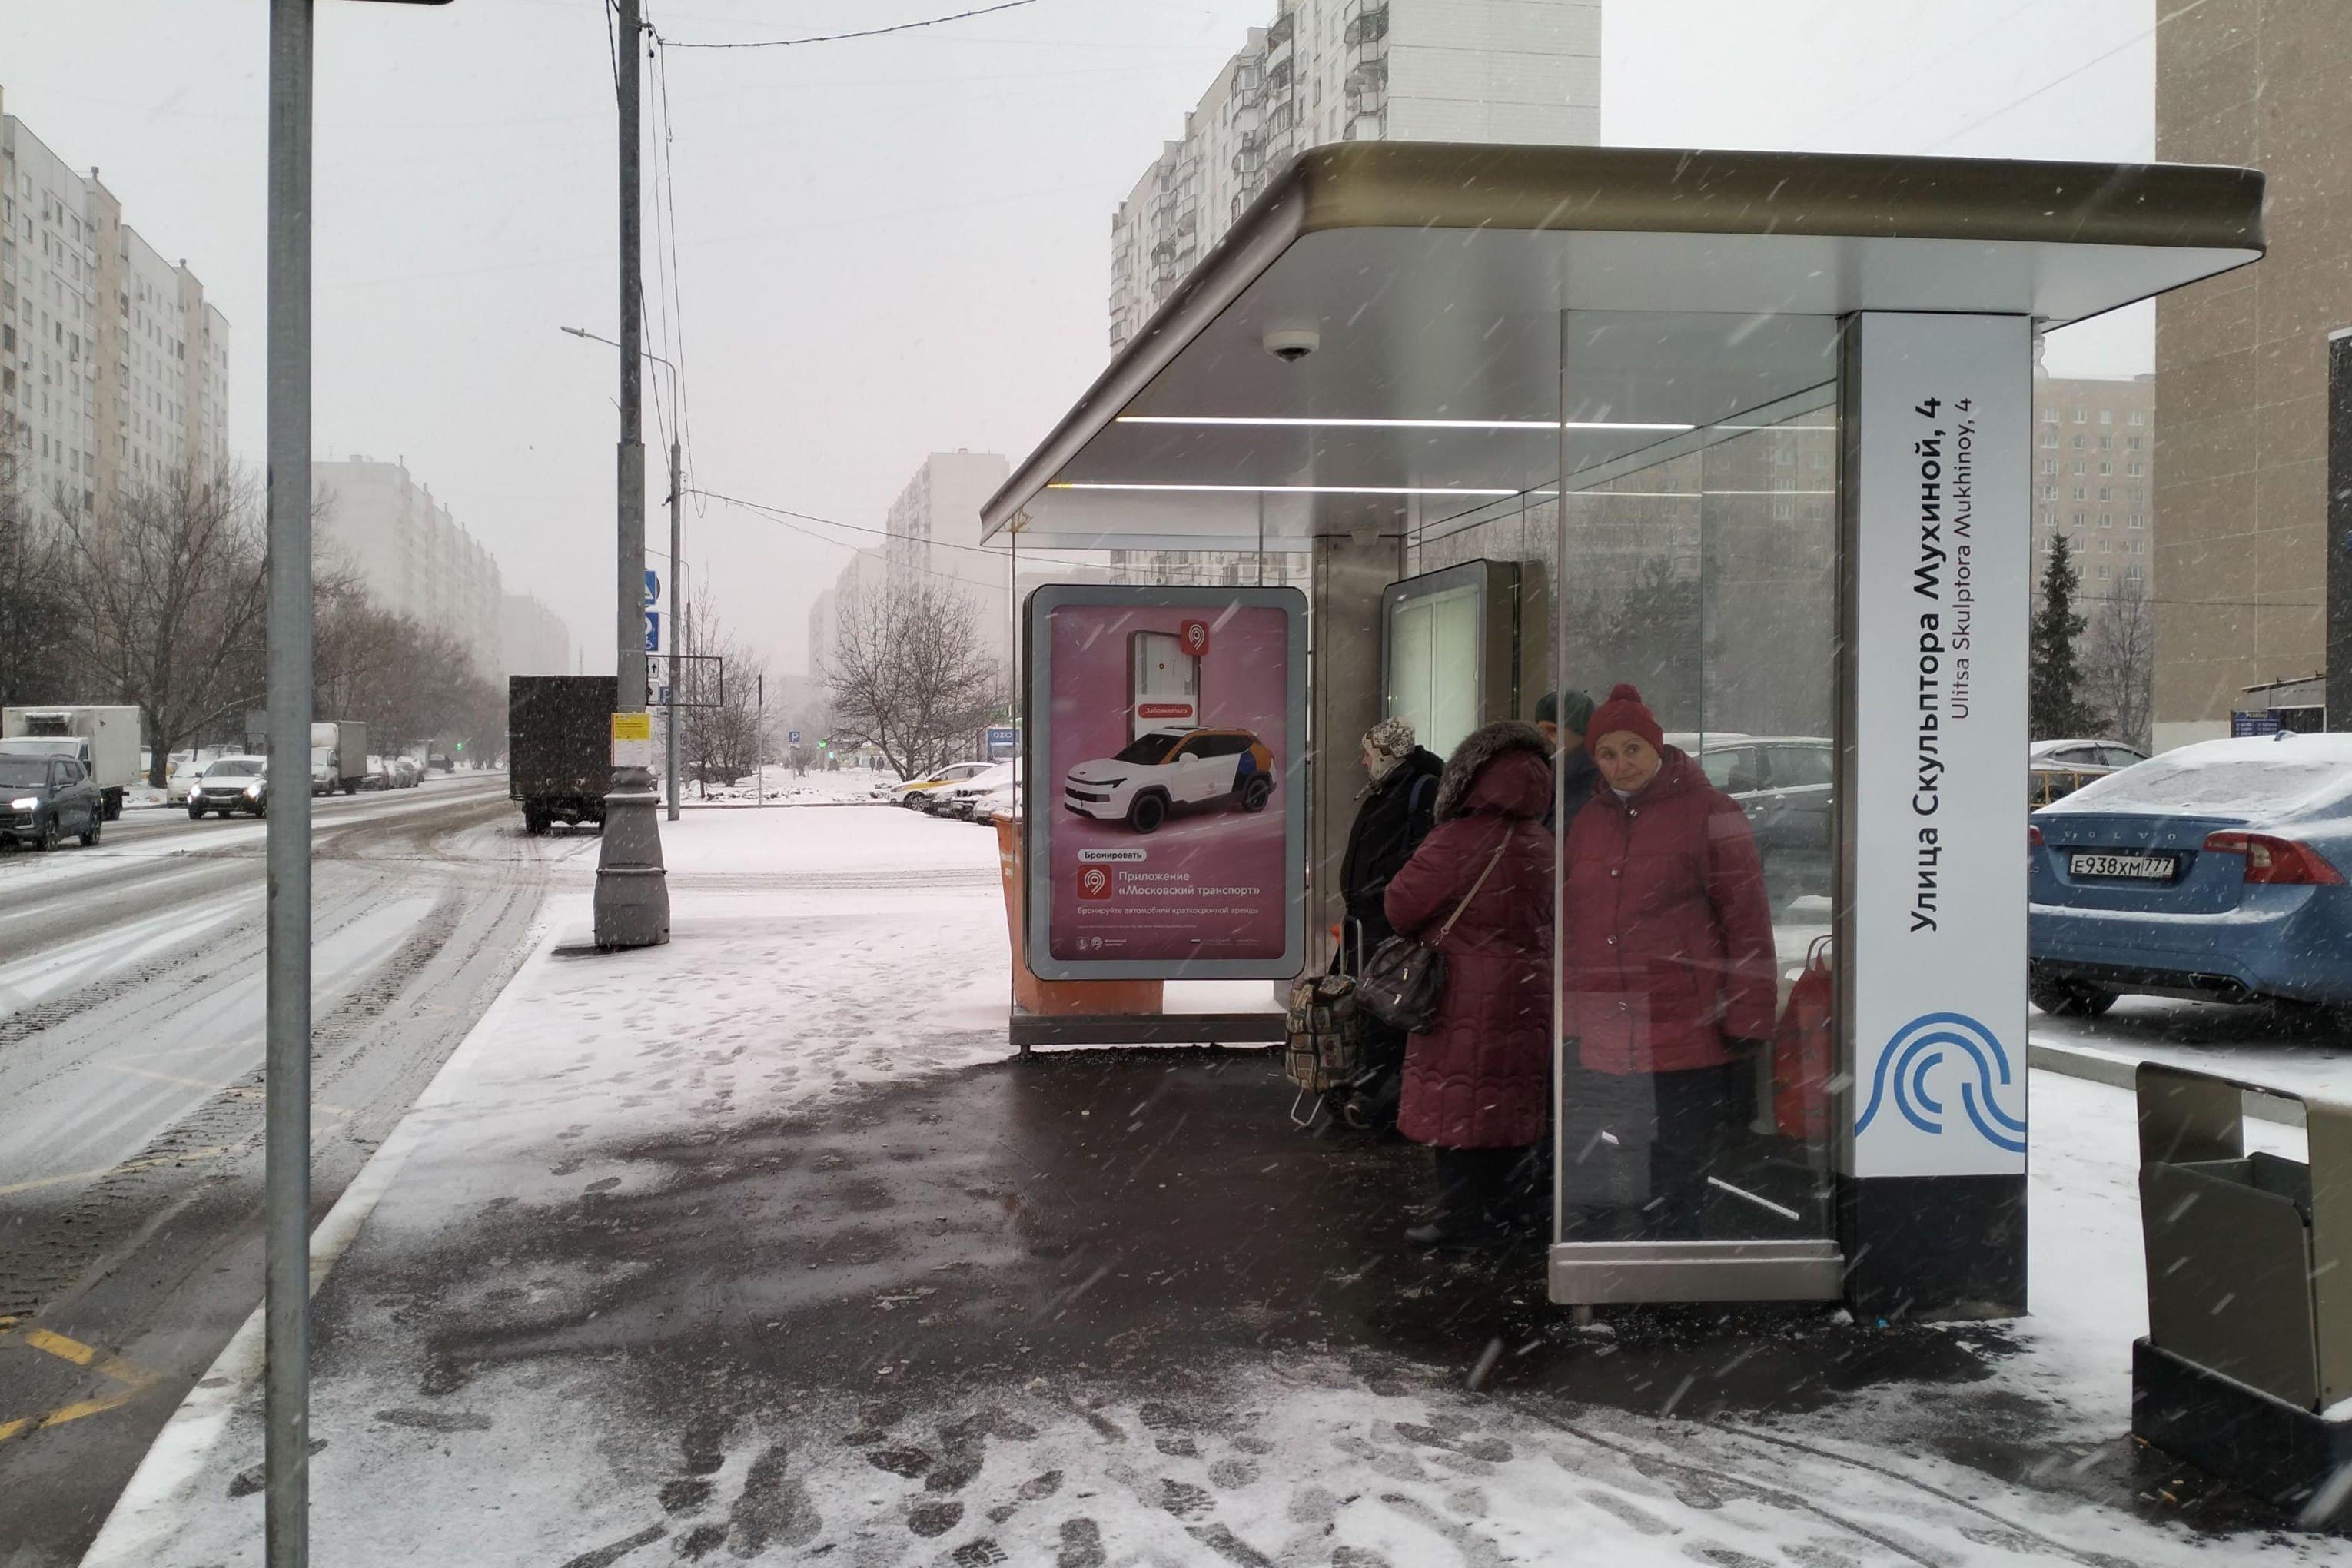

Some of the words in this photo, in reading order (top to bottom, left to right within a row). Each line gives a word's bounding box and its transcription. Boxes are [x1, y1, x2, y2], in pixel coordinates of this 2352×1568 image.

[1915, 397, 1942, 419] 4
[1955, 397, 1972, 412] 4
[1952, 420, 1975, 538] Mukhinoy,
[1913, 429, 1947, 600] Мухиной,
[1952, 544, 1975, 650] Skulptora
[1950, 657, 1970, 719] Ulitsa
[1912, 613, 1945, 816] Скульптора
[2064, 830, 2177, 841] VOLVO
[1084, 851, 1142, 860] Бронировать
[1118, 871, 1190, 883] Приложение
[1911, 827, 1943, 932] Улица
[1118, 885, 1194, 896] «Московский
[1197, 886, 1261, 897] транспорт»
[1077, 906, 1122, 915] Бронируйте
[1124, 906, 1170, 915] автомобили
[1172, 906, 1229, 916] краткосрочной
[1231, 907, 1259, 916] аренды
